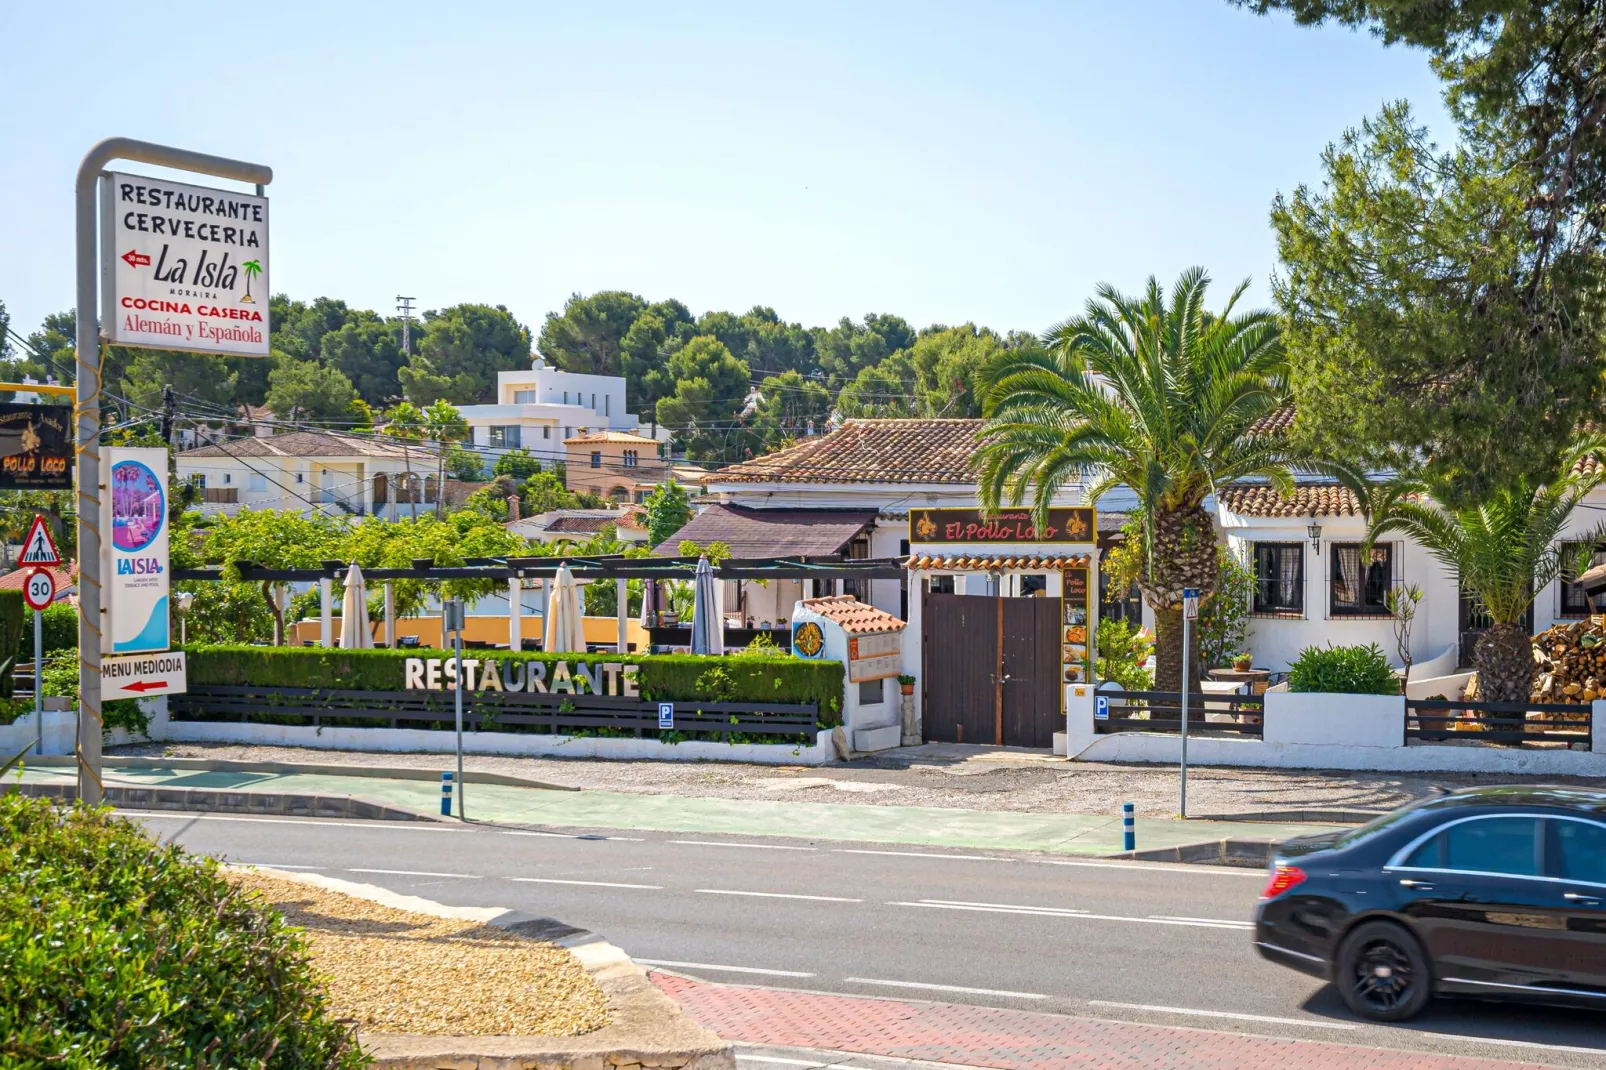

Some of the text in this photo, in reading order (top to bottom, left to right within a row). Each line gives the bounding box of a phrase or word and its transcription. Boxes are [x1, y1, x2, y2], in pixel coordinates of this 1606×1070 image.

[120, 184, 263, 223] RESTAURANTE
[124, 212, 260, 248] CERVECERIA
[153, 244, 238, 290] La Isla
[170, 288, 218, 300] MORAIRA
[121, 297, 263, 322] COCINA CASERA
[123, 313, 263, 344] Alemán y Española
[3, 455, 66, 472] POLLO LOCO
[944, 521, 1059, 540] El Pollo Loo
[31, 582, 49, 597] 30
[102, 658, 183, 679] MENU MEDIODIA
[405, 658, 640, 698] RESTAURANTE
[661, 706, 671, 719] P
[1096, 697, 1107, 714] P
